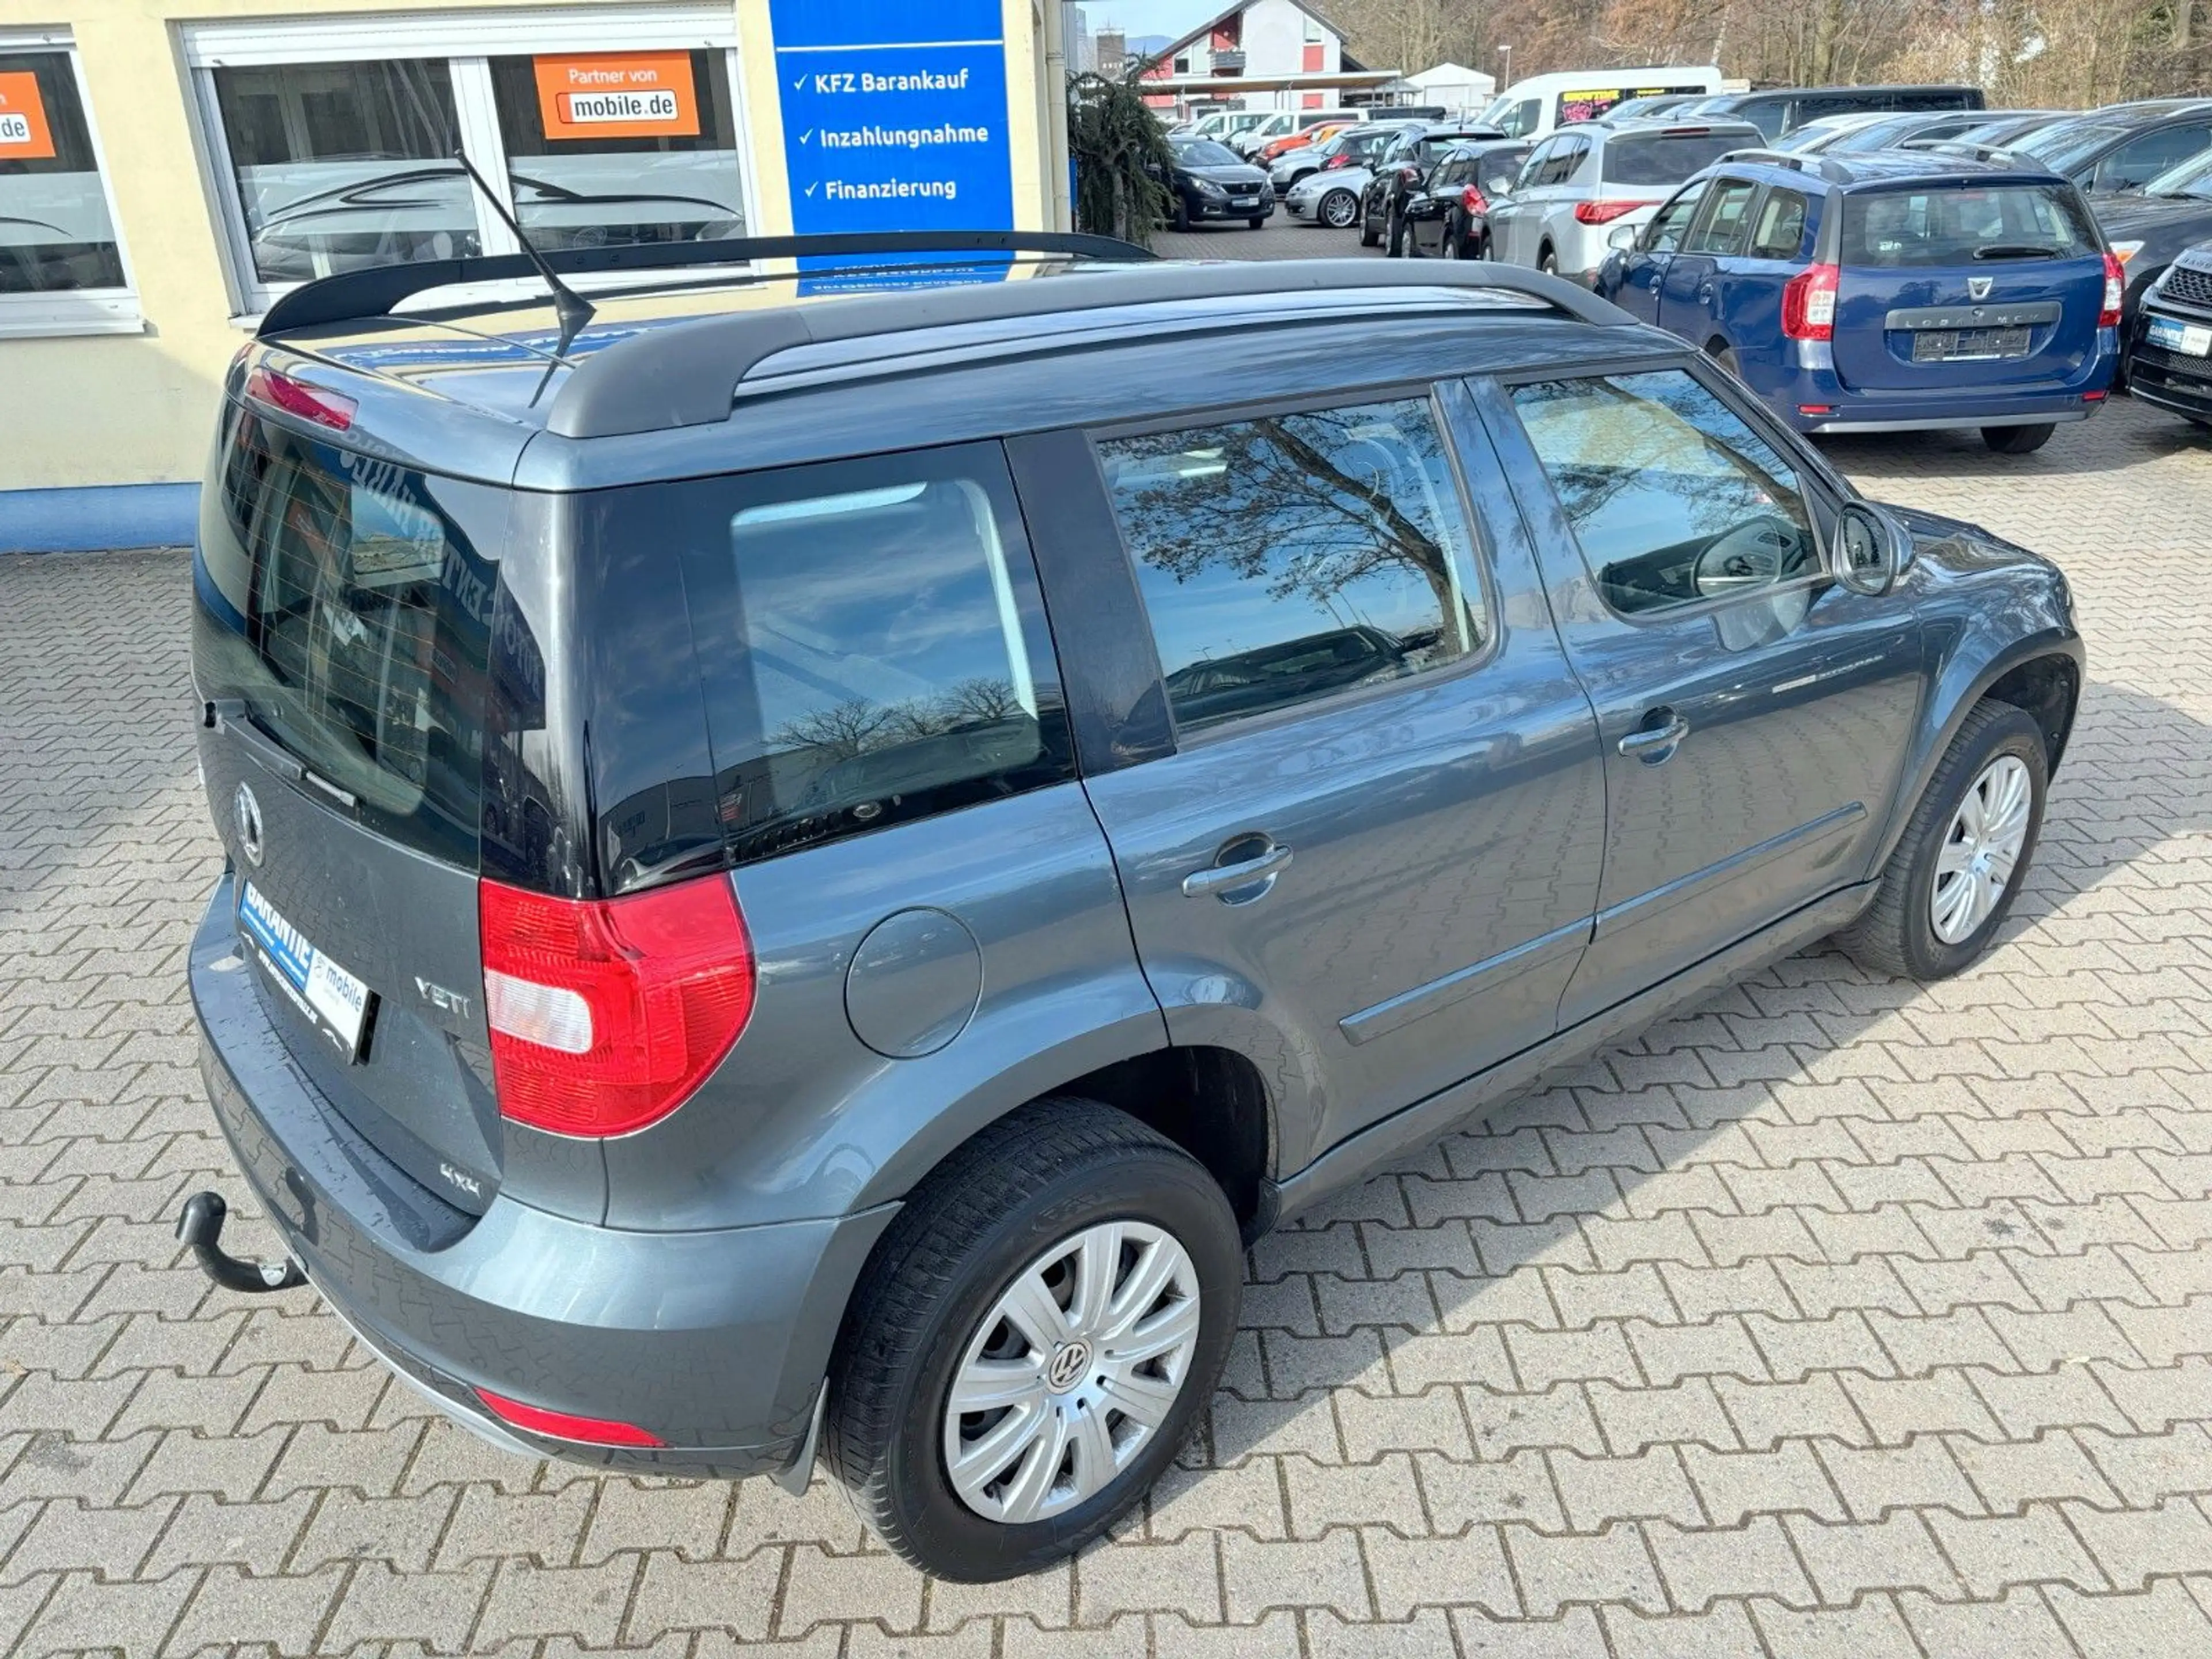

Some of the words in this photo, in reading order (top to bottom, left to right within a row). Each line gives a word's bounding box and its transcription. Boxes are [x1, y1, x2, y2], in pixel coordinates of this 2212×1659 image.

[569, 68, 626, 84] Partner
[629, 69, 657, 82] von
[815, 73, 856, 93] KFZ
[861, 68, 969, 92] Barankauf
[574, 94, 673, 116] mobile.de
[820, 123, 989, 149] Inzahlungnahme
[825, 177, 957, 200] Finanzierung
[247, 881, 312, 969] GARANTIE
[325, 965, 363, 1013] mobile
[415, 976, 470, 1018] YETI
